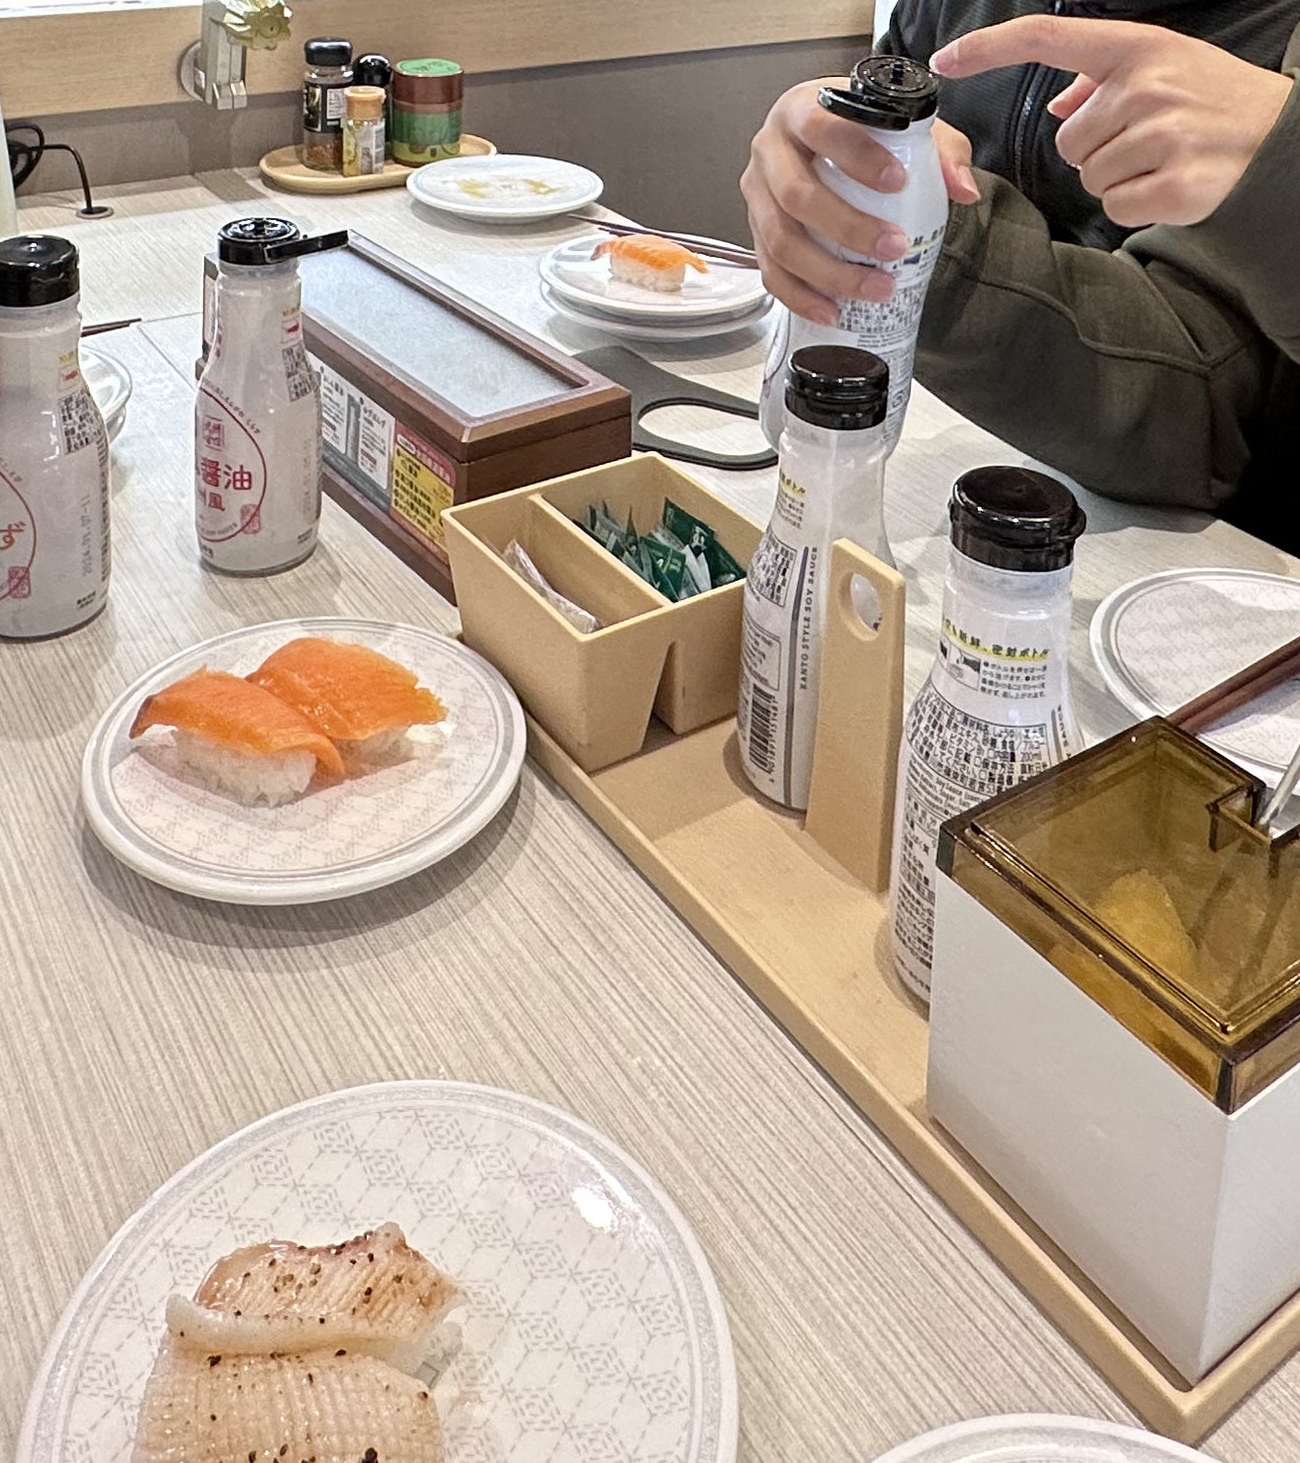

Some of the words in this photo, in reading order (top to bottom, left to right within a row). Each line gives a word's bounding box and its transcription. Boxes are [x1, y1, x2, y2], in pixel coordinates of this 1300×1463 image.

[809, 547, 818, 585] SAUCE
[804, 589, 814, 612] SOY
[802, 614, 812, 650] STYLE
[800, 653, 810, 690] KANTO
